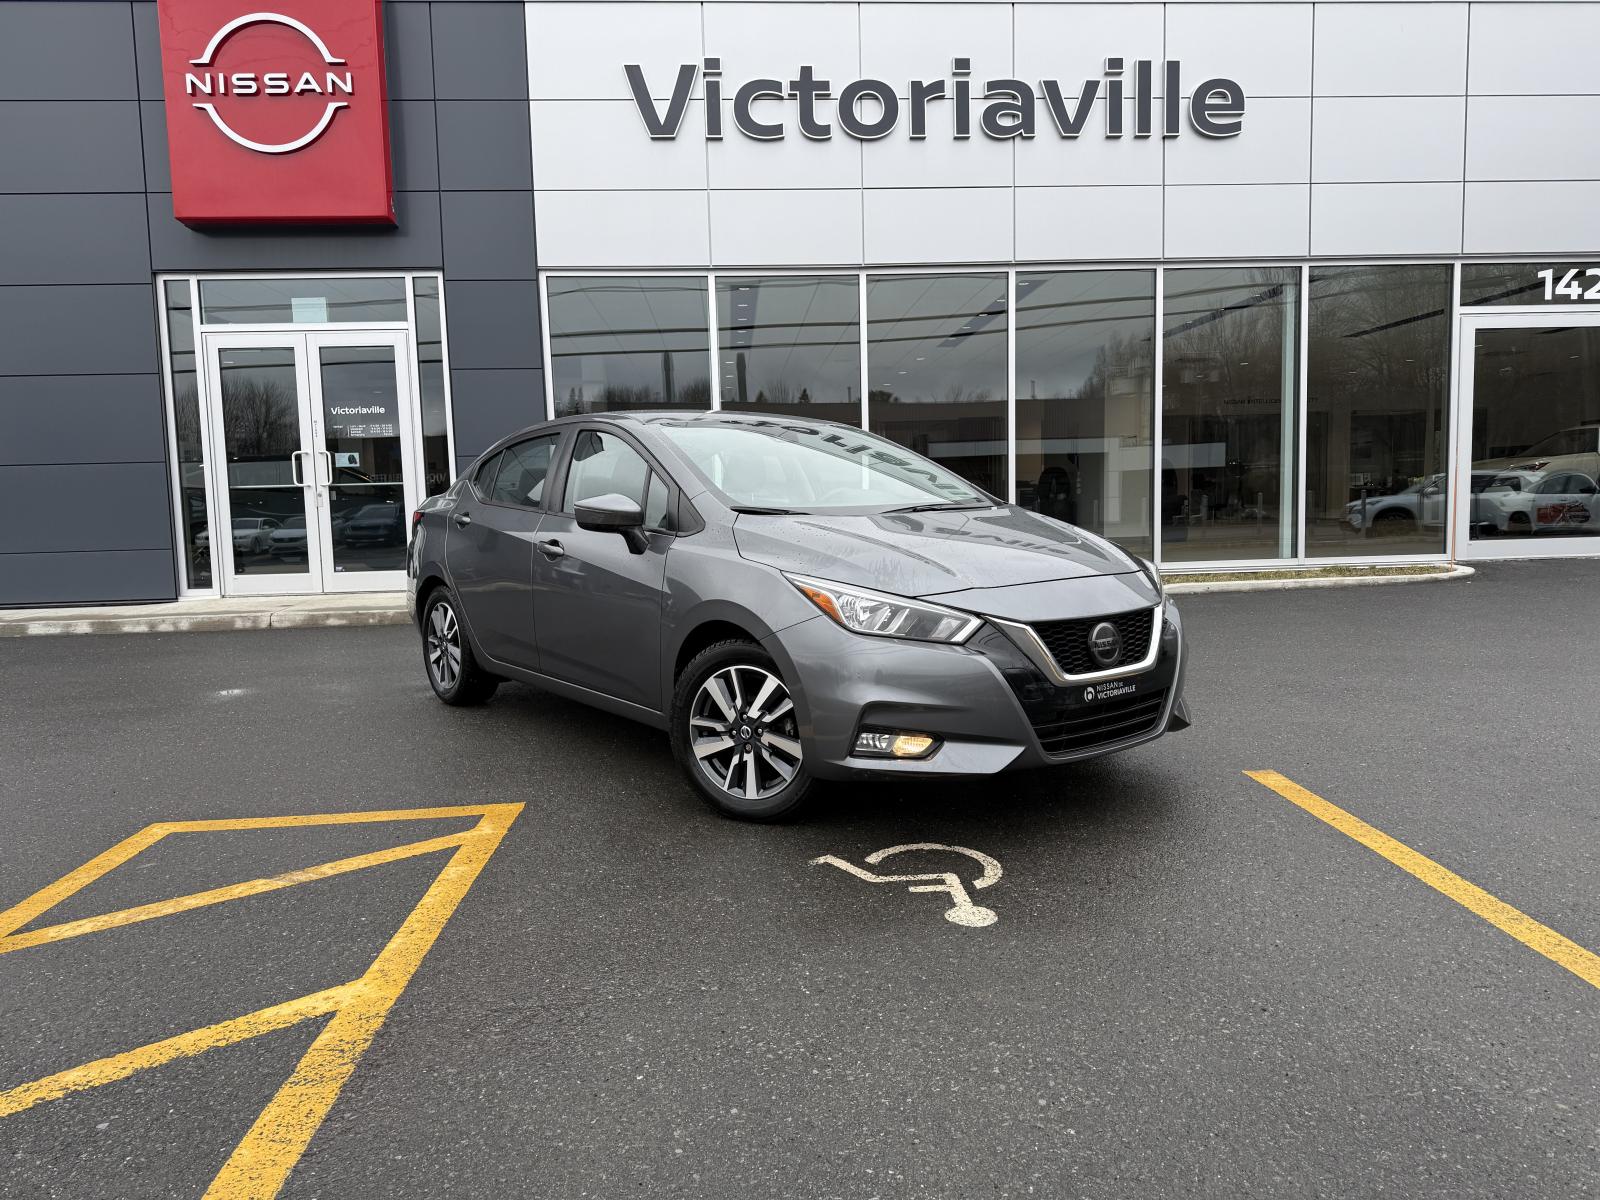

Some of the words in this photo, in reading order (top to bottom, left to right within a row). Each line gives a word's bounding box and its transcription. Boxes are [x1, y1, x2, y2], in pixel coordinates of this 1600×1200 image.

[185, 72, 354, 95] NISSAN
[623, 57, 1246, 142] Victoriaville
[330, 406, 386, 415] Victoriaville
[1096, 681, 1118, 692] NISSAN
[1097, 684, 1136, 700] VICTORIAVILLE
